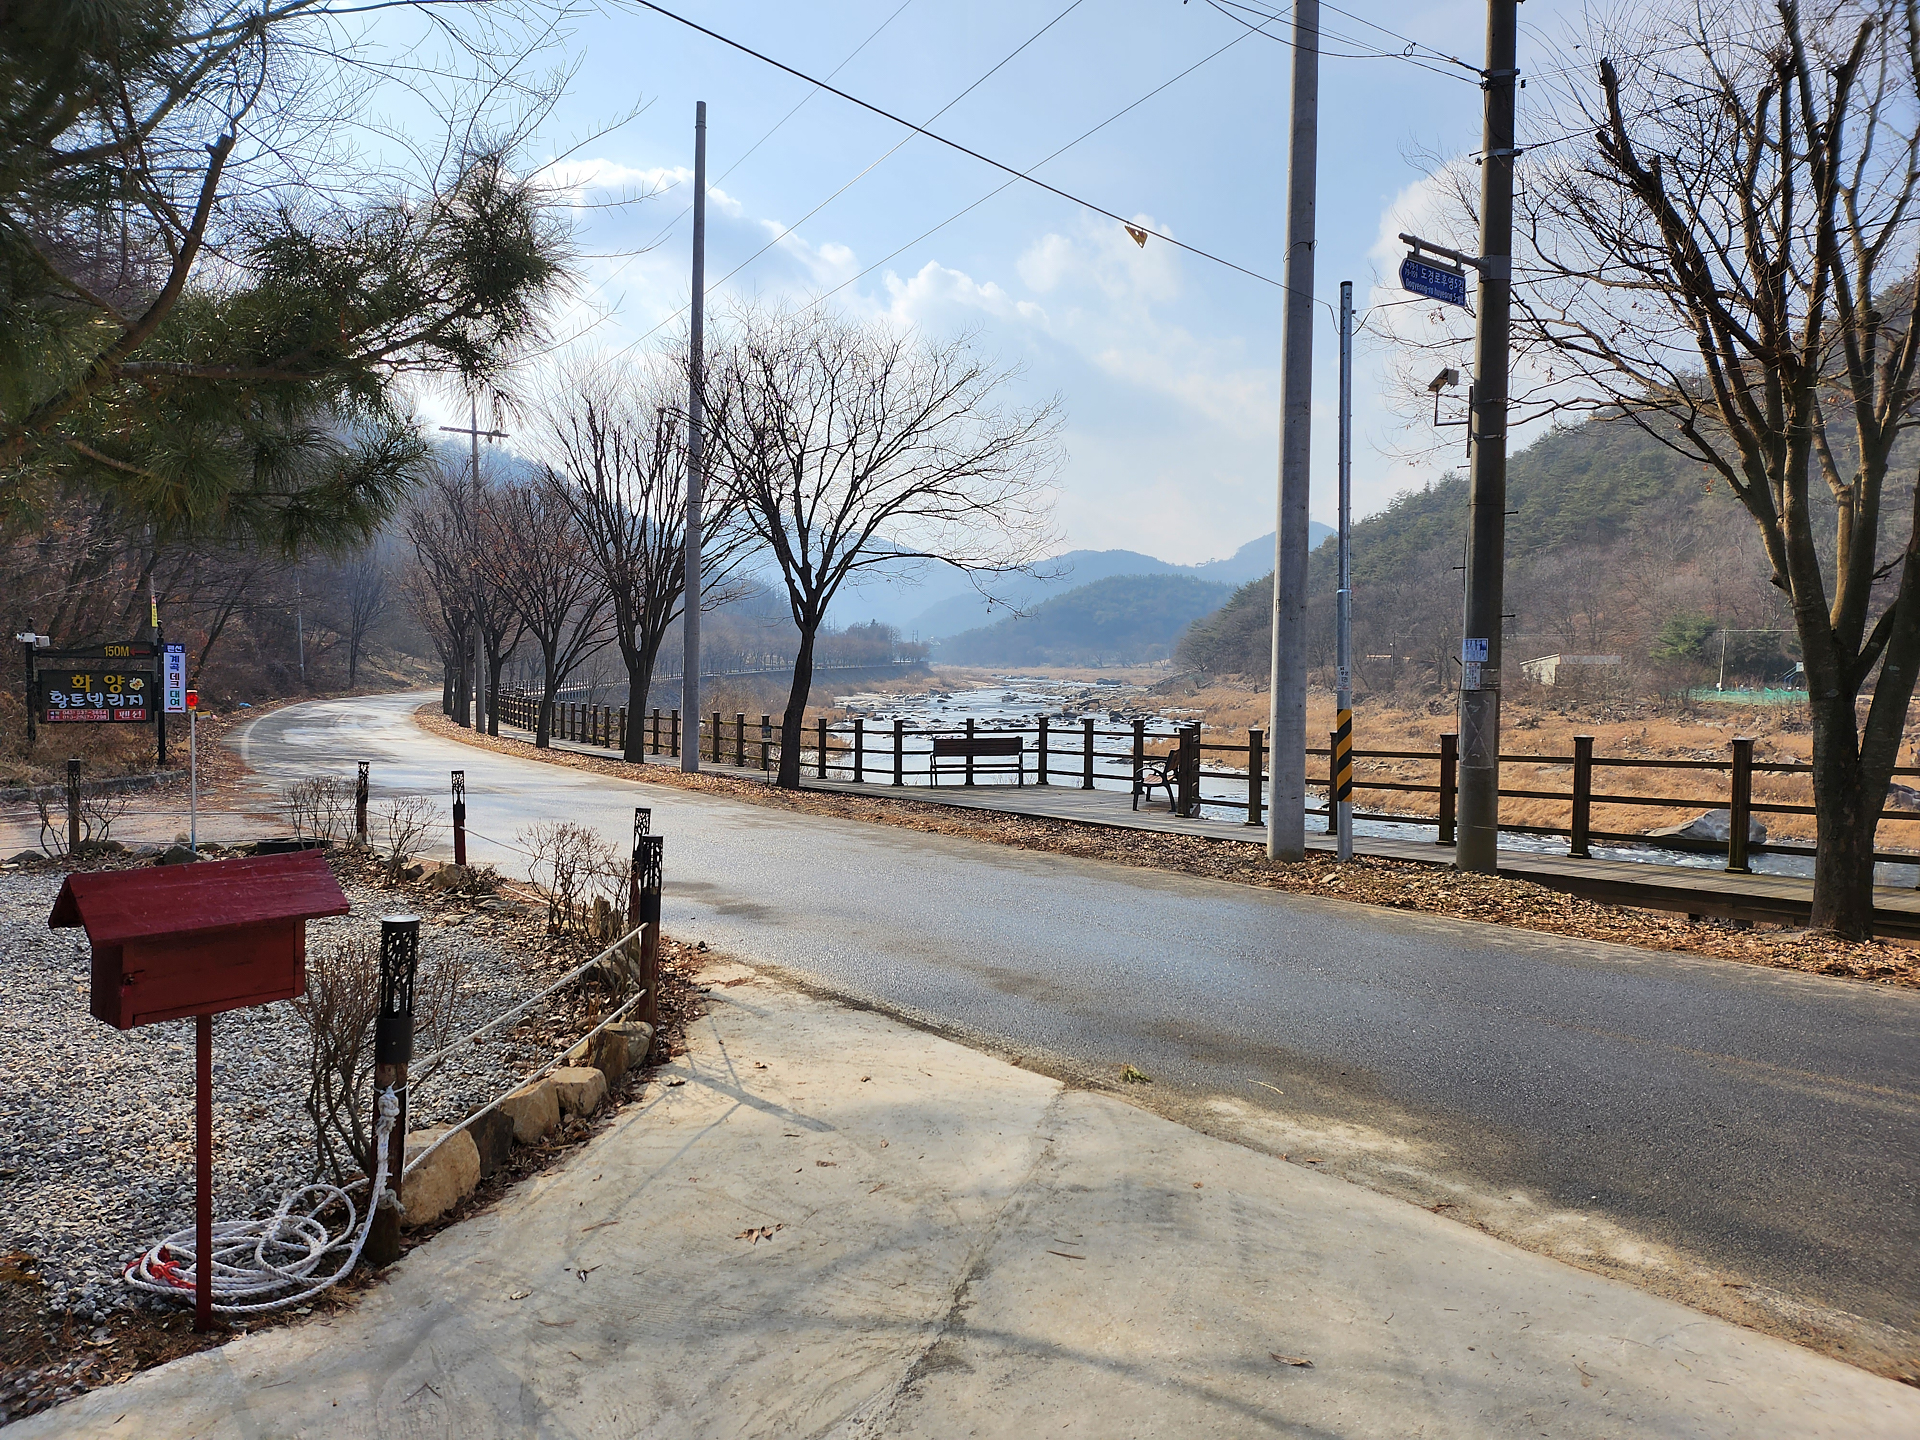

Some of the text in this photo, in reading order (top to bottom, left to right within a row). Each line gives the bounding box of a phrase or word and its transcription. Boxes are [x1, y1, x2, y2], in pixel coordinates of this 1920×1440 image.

[1421, 268, 1464, 294] 도경로후영5길
[104, 645, 130, 657] 150M
[169, 672, 180, 689] 데크
[49, 690, 144, 709] 황토빌리지
[169, 690, 180, 706] 대여
